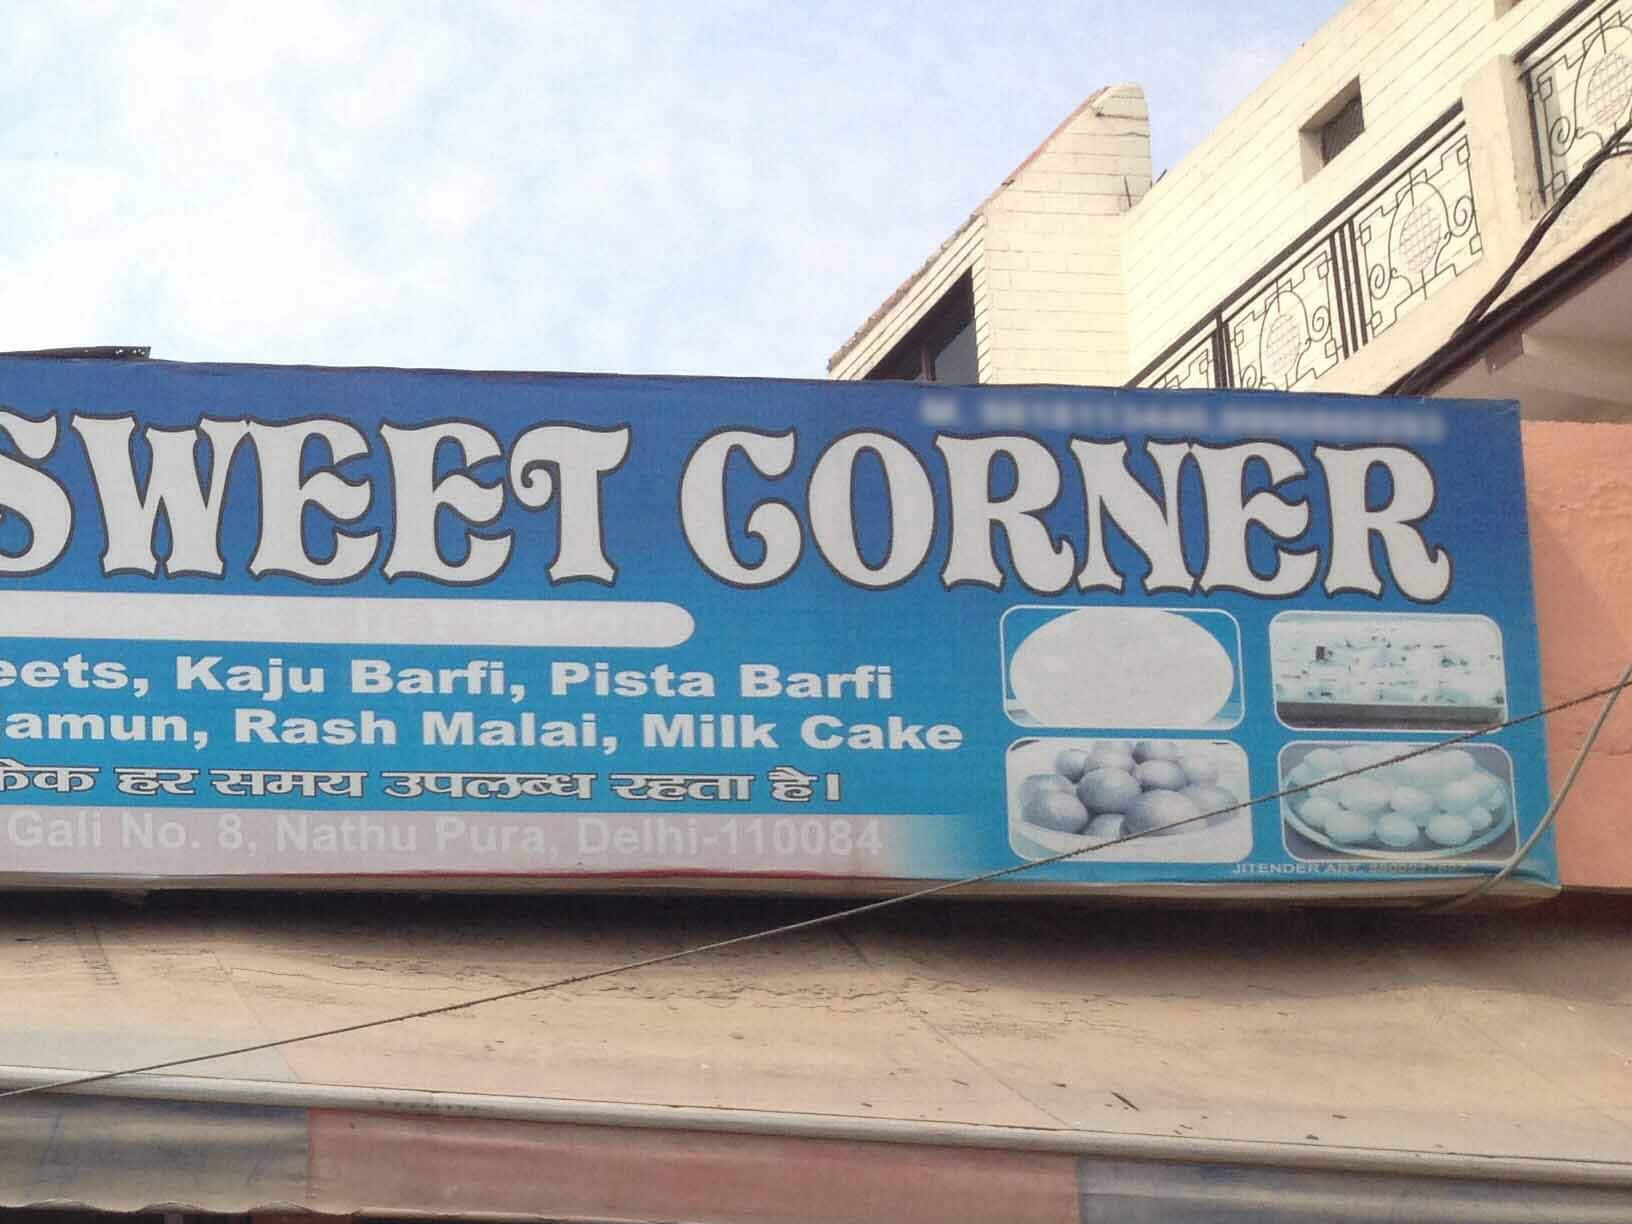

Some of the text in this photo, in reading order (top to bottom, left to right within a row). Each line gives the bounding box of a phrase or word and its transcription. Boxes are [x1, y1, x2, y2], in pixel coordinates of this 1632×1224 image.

[678, 425, 1453, 601] CORNER
[176, 655, 325, 701] Kaju
[351, 658, 525, 703] Barfi,
[551, 662, 715, 698] Pista
[740, 663, 893, 700] Barfi
[235, 708, 396, 745] Rash
[422, 711, 619, 755] Malai,
[643, 713, 779, 749] Milk
[801, 715, 963, 750] Cake
[113, 766, 199, 796] हर
[209, 768, 369, 798] समय
[382, 768, 597, 801] उपलब्ध
[608, 772, 755, 801] रहता
[8, 811, 101, 850] Gali
[124, 814, 202, 850] No.
[277, 814, 416, 853] Nathu
[435, 816, 560, 859] Pura,
[577, 816, 884, 857] Delhi-110084
[1232, 863, 1318, 874] JITENDER
